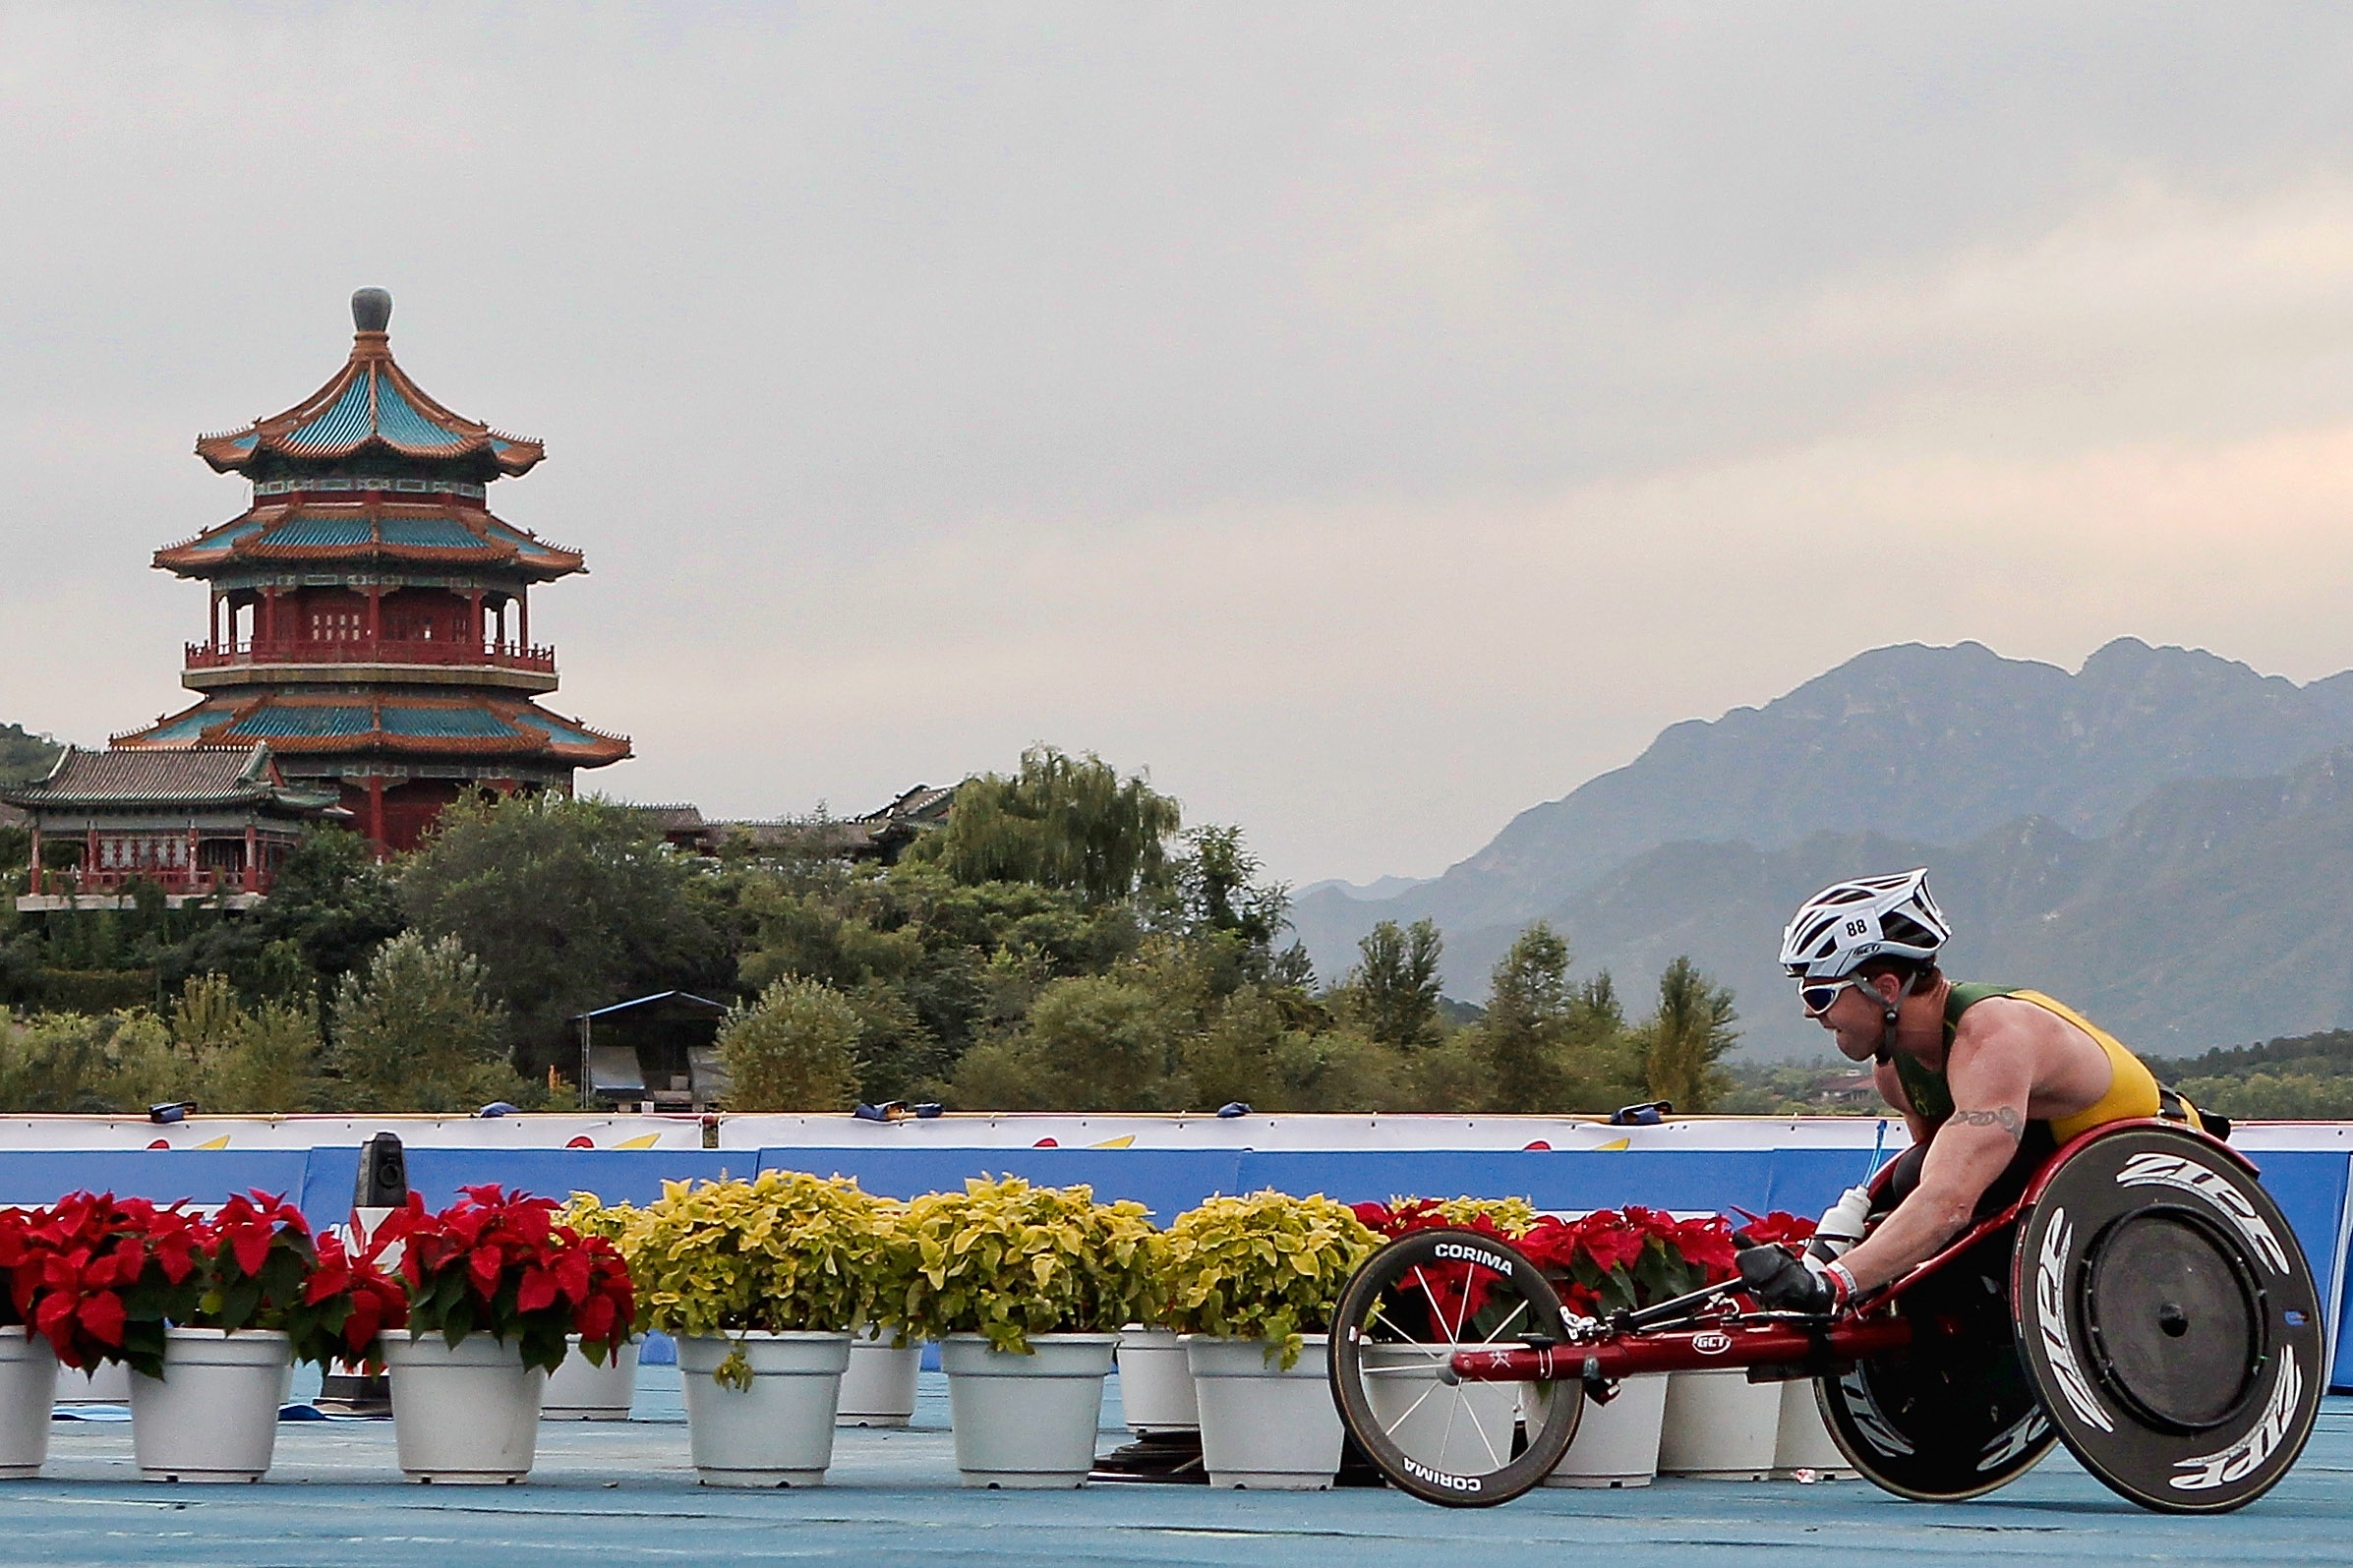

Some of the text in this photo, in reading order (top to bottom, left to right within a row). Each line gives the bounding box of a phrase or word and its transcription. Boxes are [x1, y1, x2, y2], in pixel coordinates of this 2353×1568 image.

[1847, 919, 1867, 937] 88
[2116, 1152, 2290, 1276] ZIPP
[1435, 1243, 1512, 1276] CORIMA
[2036, 1206, 2115, 1433] ZIPP
[2169, 1344, 2304, 1491] ZIPP
[1403, 1456, 1483, 1492] CORIMA
